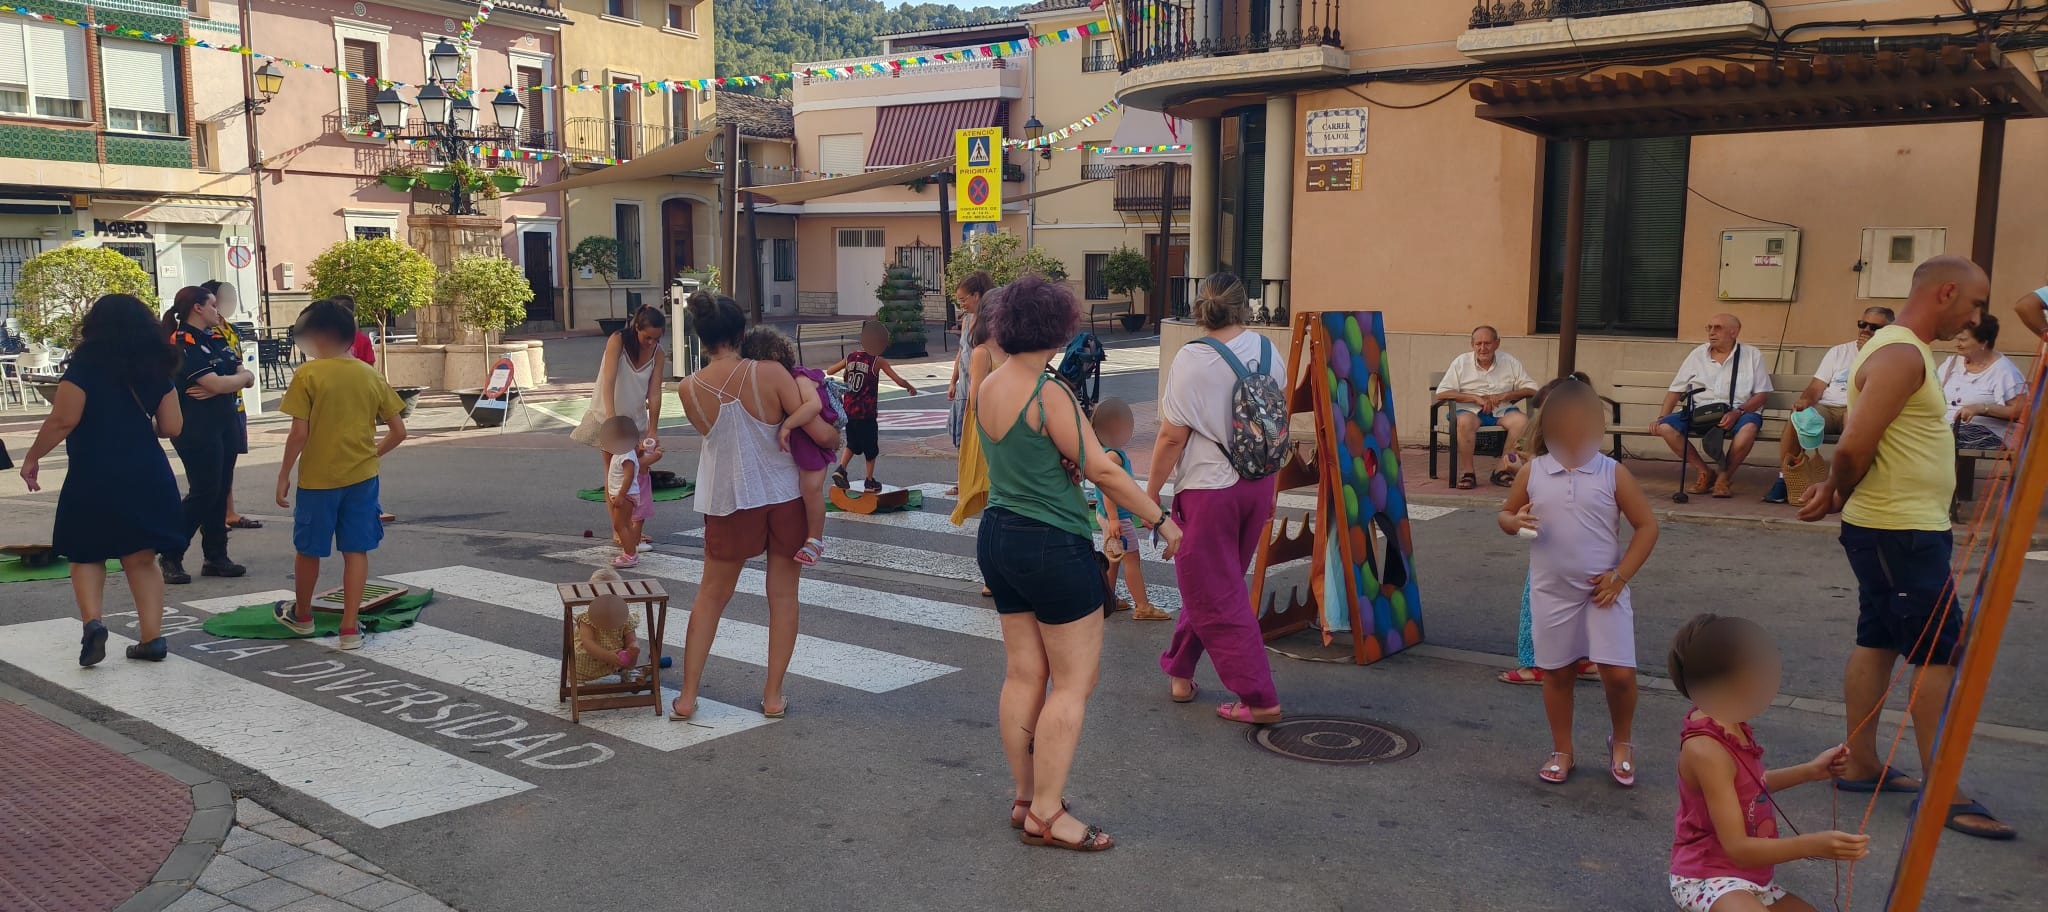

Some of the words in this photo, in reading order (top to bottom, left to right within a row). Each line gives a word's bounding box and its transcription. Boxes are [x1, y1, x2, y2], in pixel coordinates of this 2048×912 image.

[962, 129, 995, 137] ATENCIÓ
[1322, 122, 1350, 131] CARRER
[93, 218, 154, 239] MABER
[190, 638, 289, 661] LA
[264, 659, 616, 771] DIVERSIDAD
